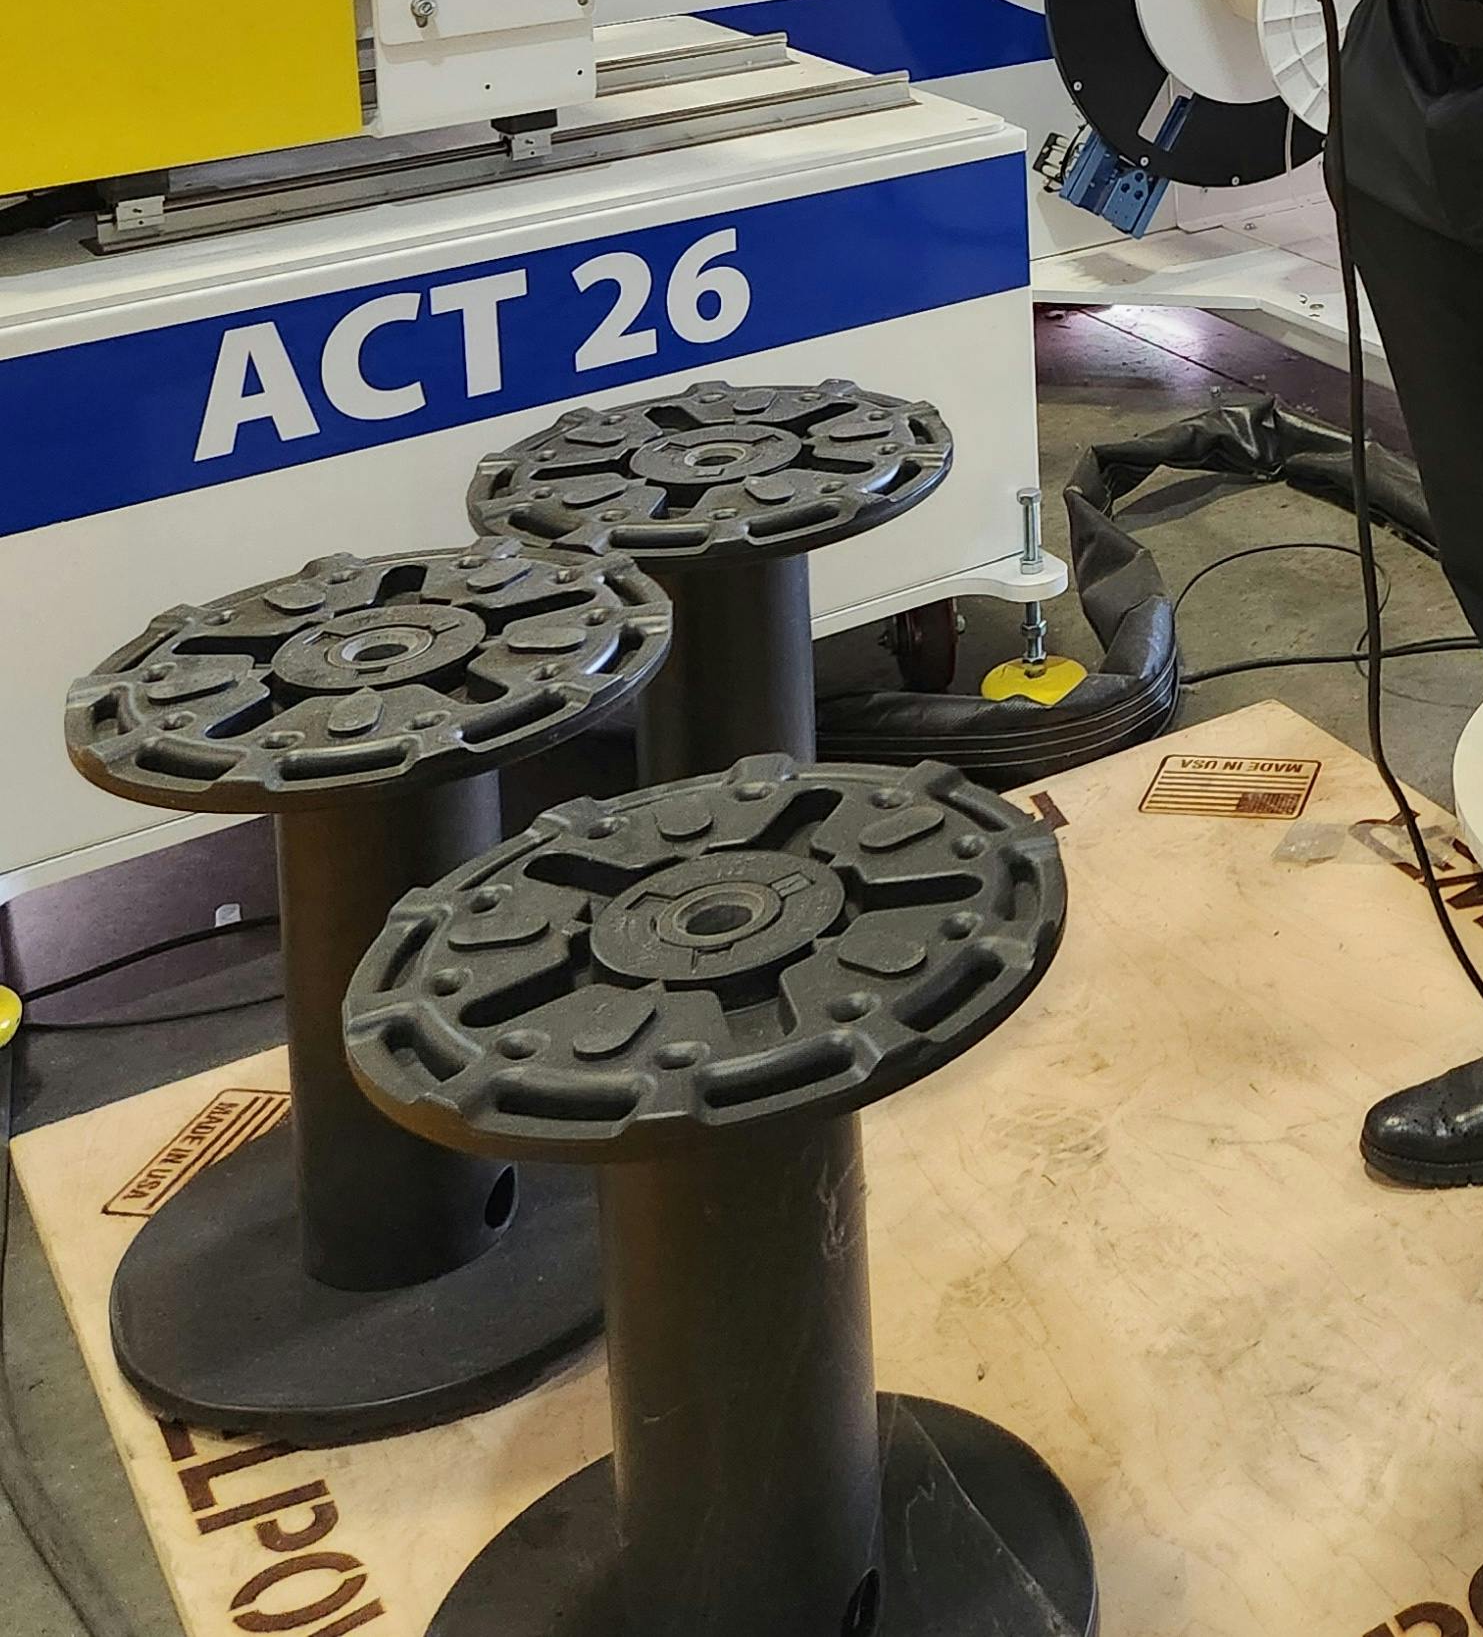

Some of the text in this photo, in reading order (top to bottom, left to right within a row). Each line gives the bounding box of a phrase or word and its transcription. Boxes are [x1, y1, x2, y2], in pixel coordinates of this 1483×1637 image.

[194, 227, 751, 461] ACT 26
[1181, 759, 1303, 773] MADE IN USA
[122, 1101, 239, 1201] MADE IN USA
